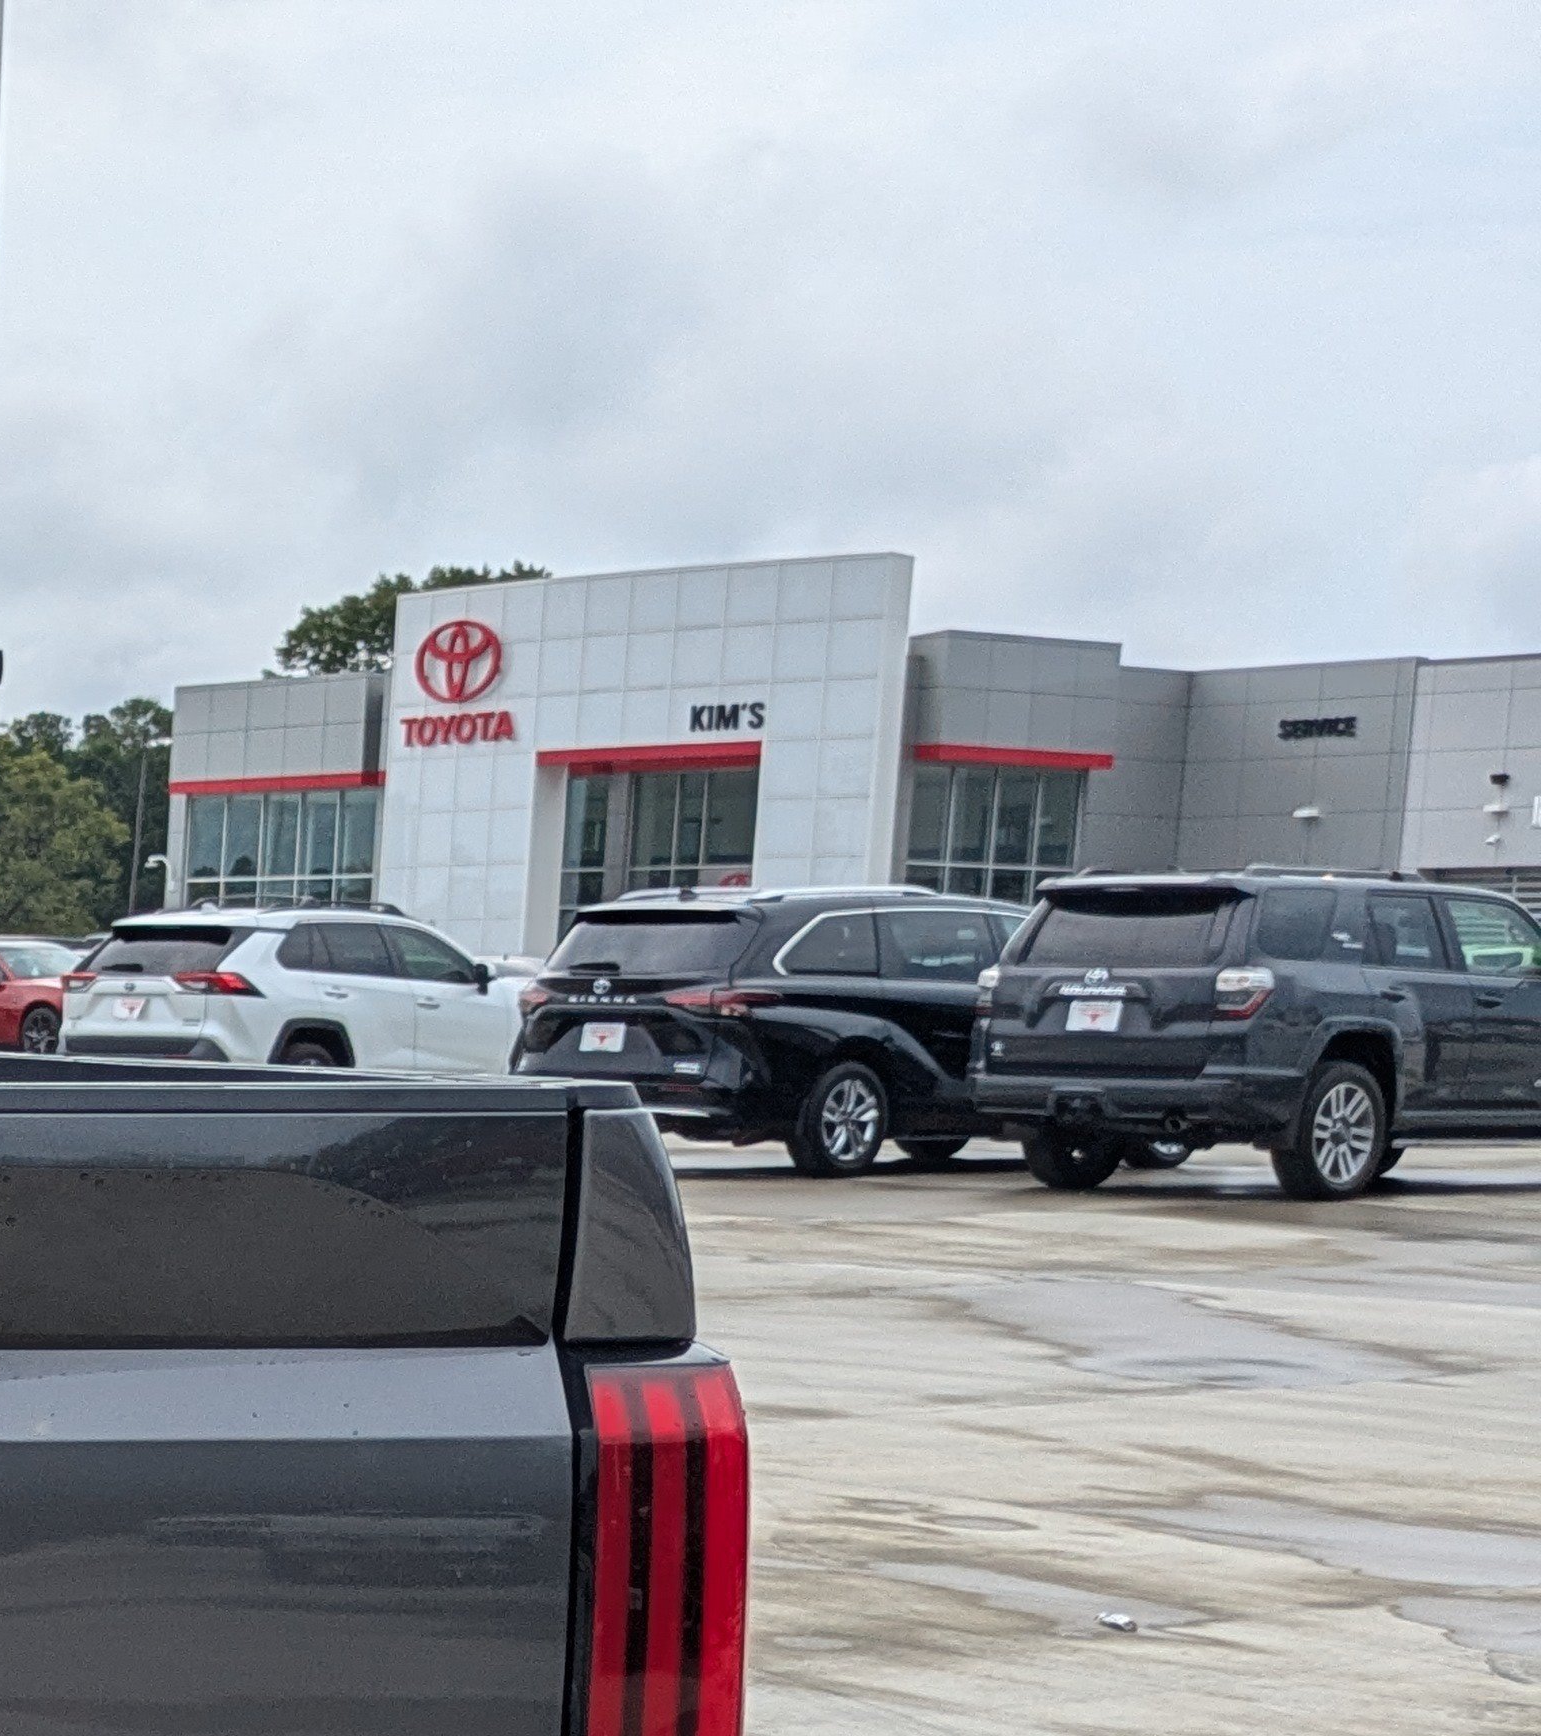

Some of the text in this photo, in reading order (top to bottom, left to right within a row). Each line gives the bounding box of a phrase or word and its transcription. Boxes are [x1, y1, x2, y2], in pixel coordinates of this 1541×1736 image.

[400, 711, 514, 747] TOYOTA
[689, 702, 765, 732] KIM'S
[1278, 717, 1357, 740] SERVICE
